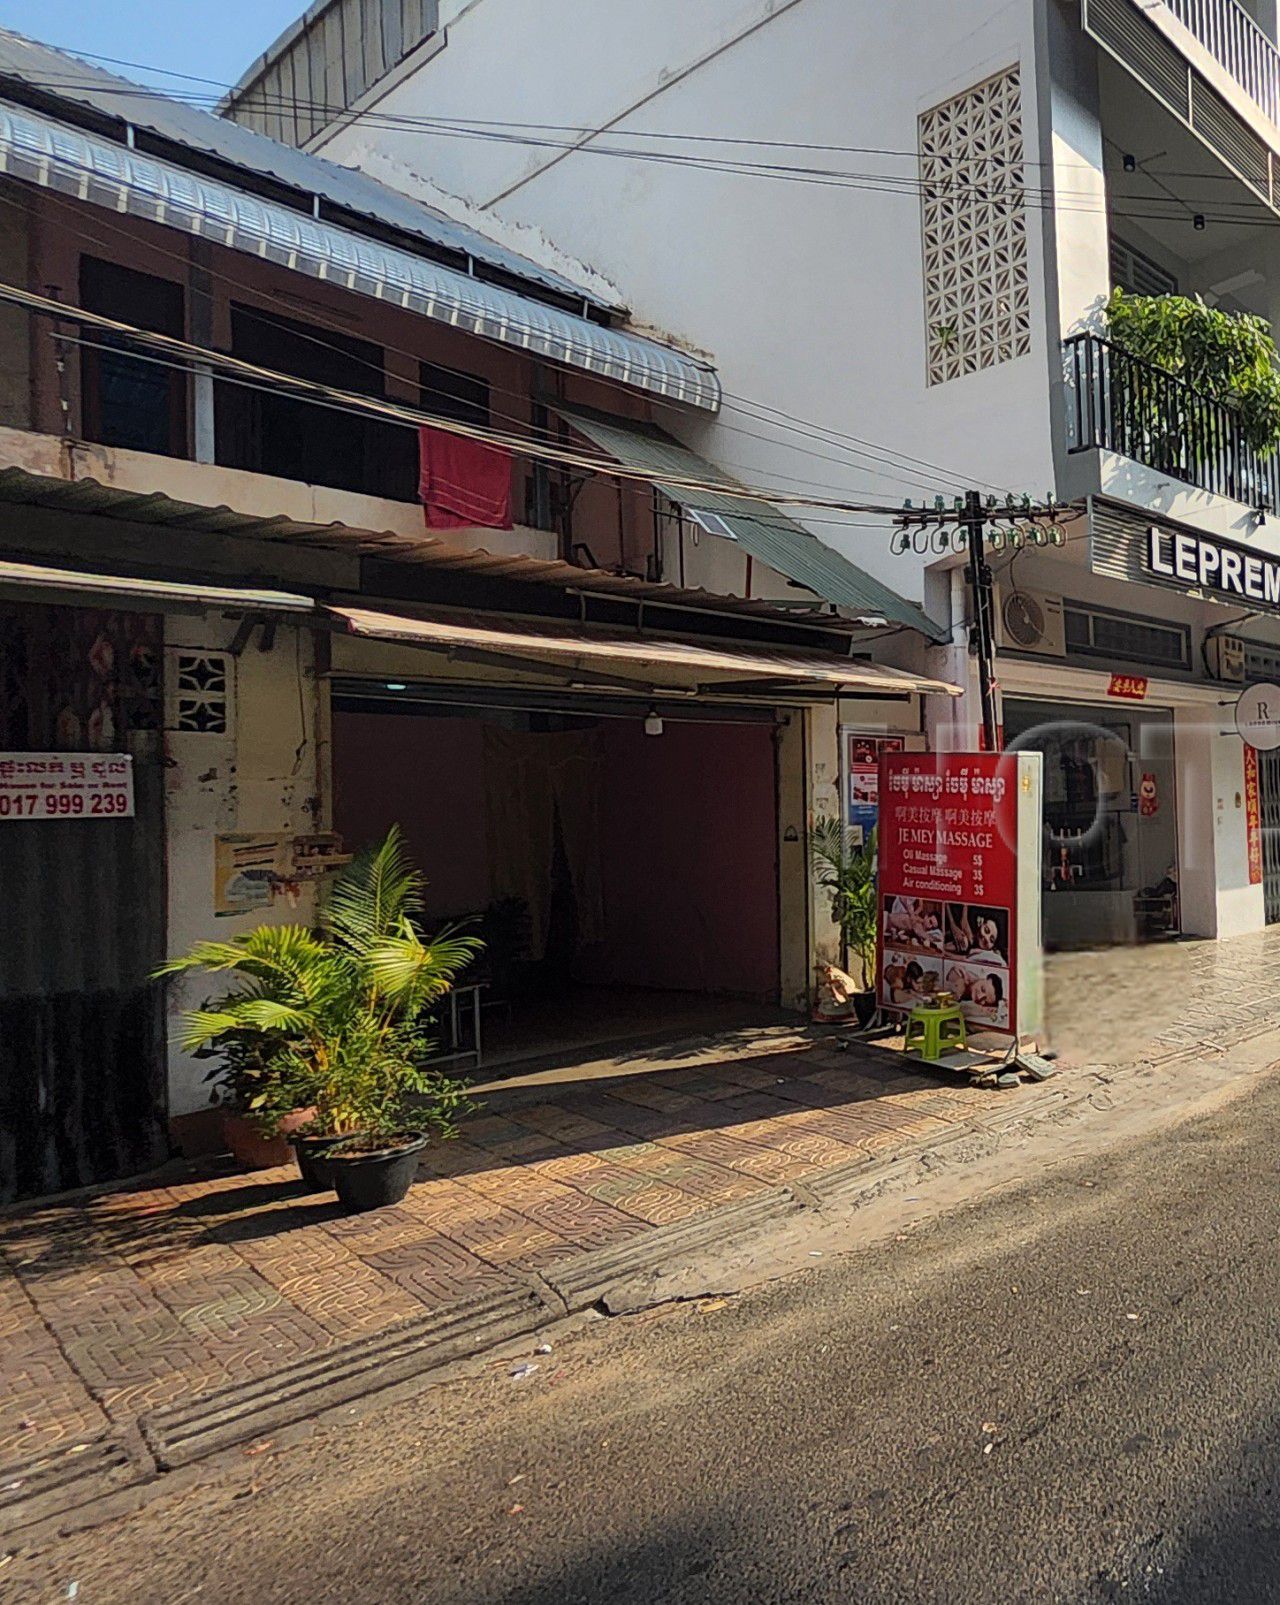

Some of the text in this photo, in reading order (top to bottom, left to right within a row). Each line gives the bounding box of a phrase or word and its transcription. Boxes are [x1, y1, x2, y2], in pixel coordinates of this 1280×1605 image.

[1256, 701, 1270, 720] R
[0, 793, 128, 816] 017 999 239
[898, 827, 993, 849] JE MEY MASSAGE
[902, 848, 914, 860] Oil
[915, 850, 948, 865] Massage
[902, 863, 928, 875] Casual
[929, 865, 963, 881] Massage
[902, 877, 914, 888] Air
[915, 880, 962, 896] conditioning
